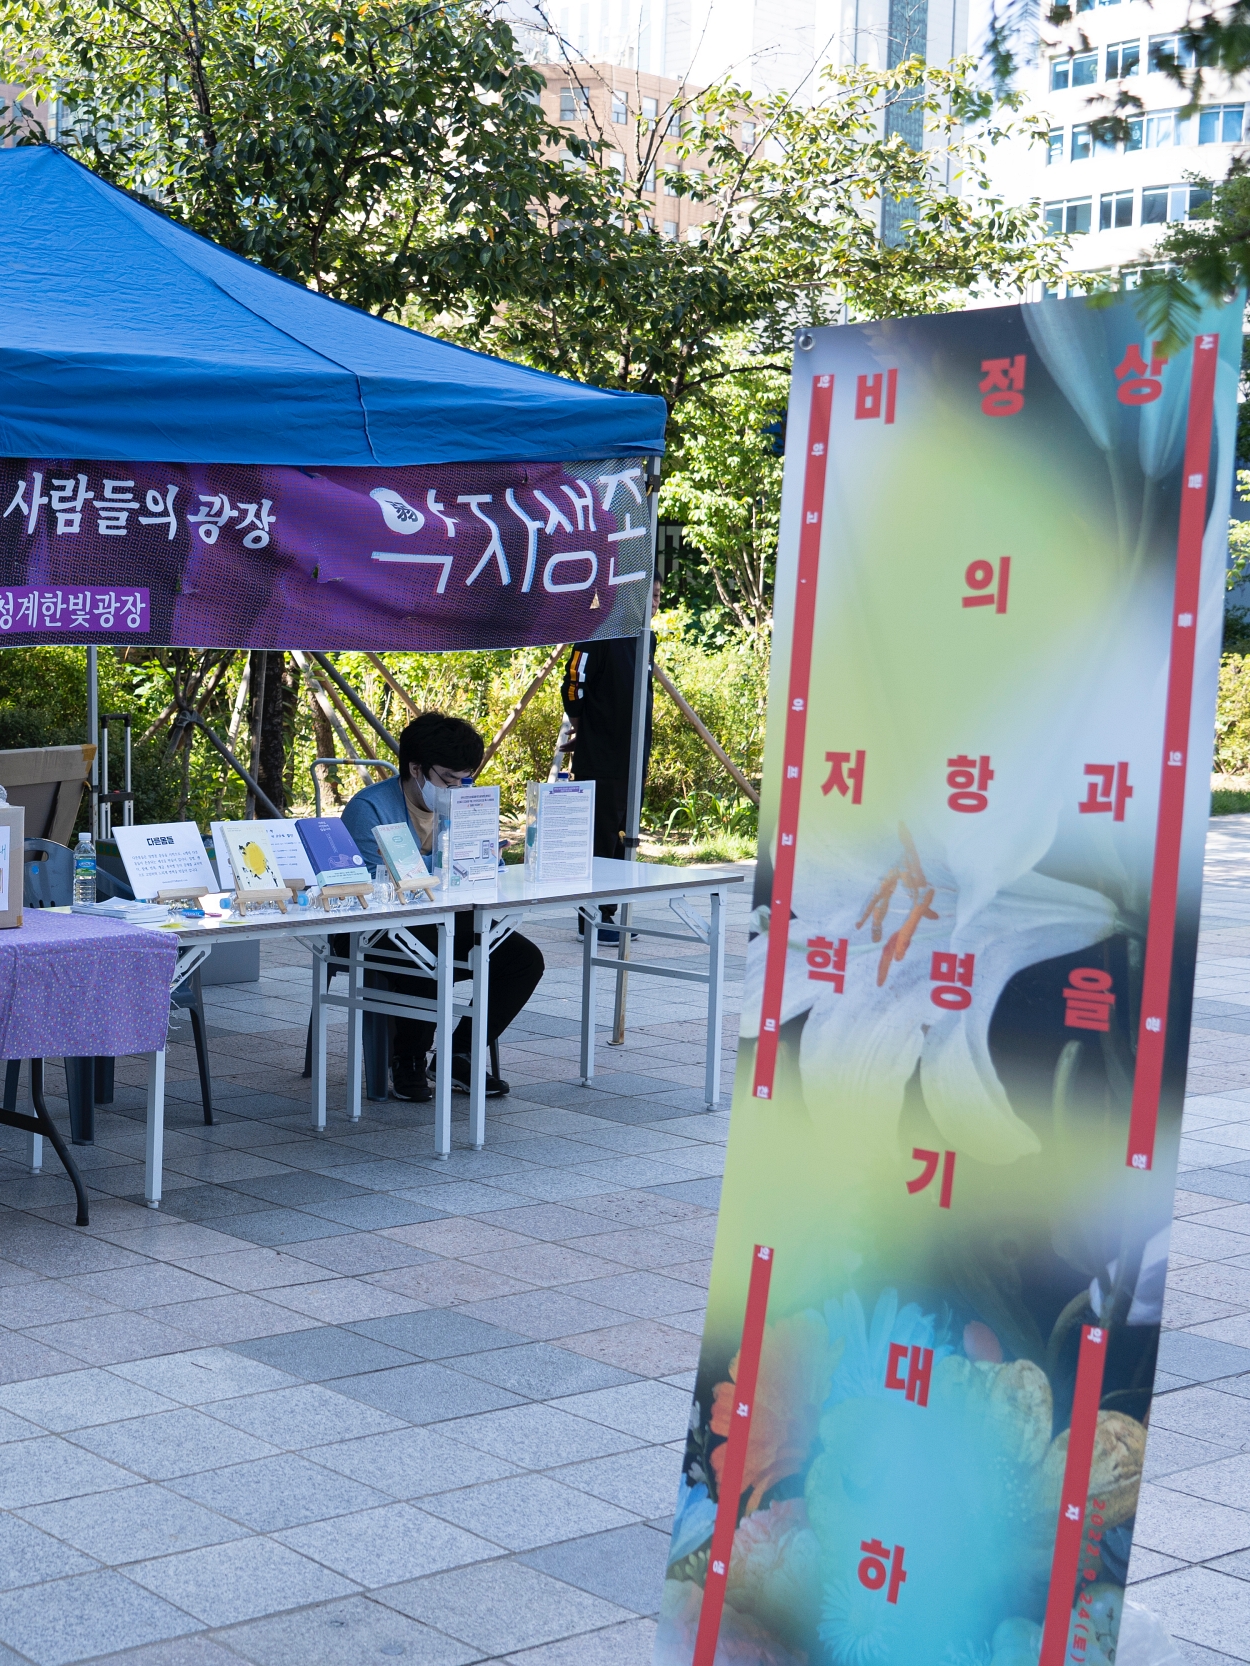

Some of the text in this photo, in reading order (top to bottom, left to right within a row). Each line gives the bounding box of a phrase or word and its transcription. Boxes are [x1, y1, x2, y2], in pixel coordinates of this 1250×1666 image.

[3, 472, 179, 541] 사람들의
[186, 493, 277, 549] 광장
[368, 468, 647, 594] 약자생존
[146, 836, 175, 846] 다른몸들
